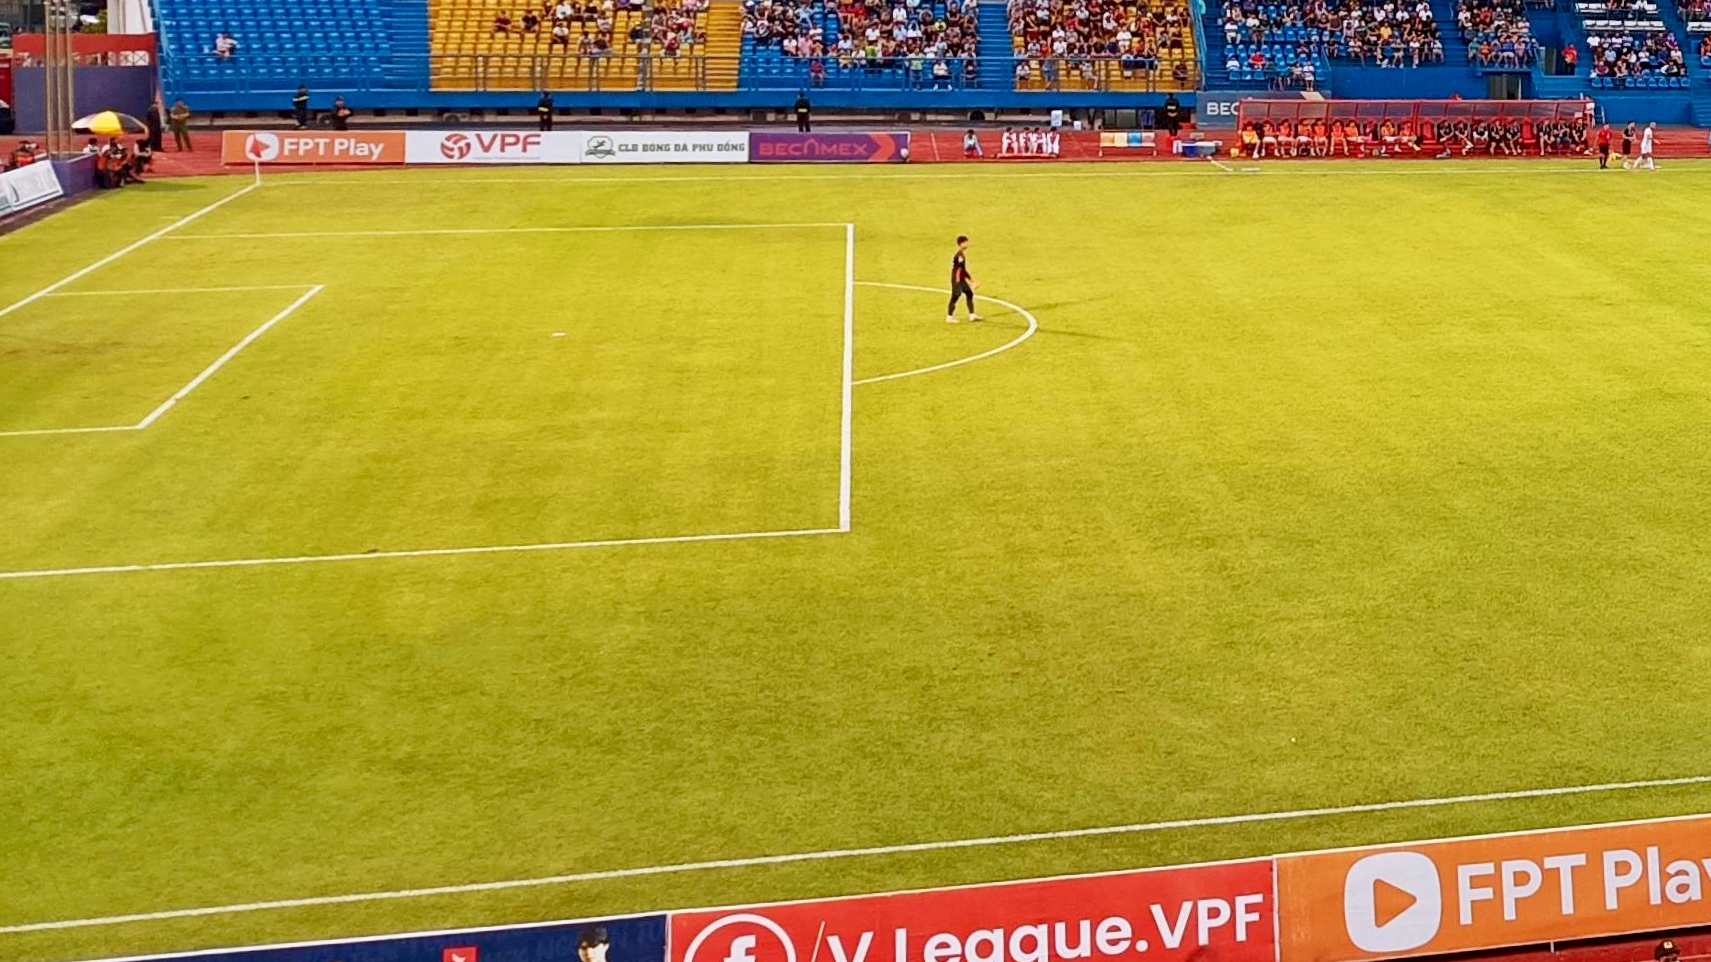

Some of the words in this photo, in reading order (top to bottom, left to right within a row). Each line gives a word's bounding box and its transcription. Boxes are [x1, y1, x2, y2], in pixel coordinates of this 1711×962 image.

[284, 137, 331, 157] FPT
[334, 137, 385, 160] Play
[475, 133, 541, 153] VPF
[759, 133, 868, 157] BECAMEX
[1457, 853, 1587, 926] FPT
